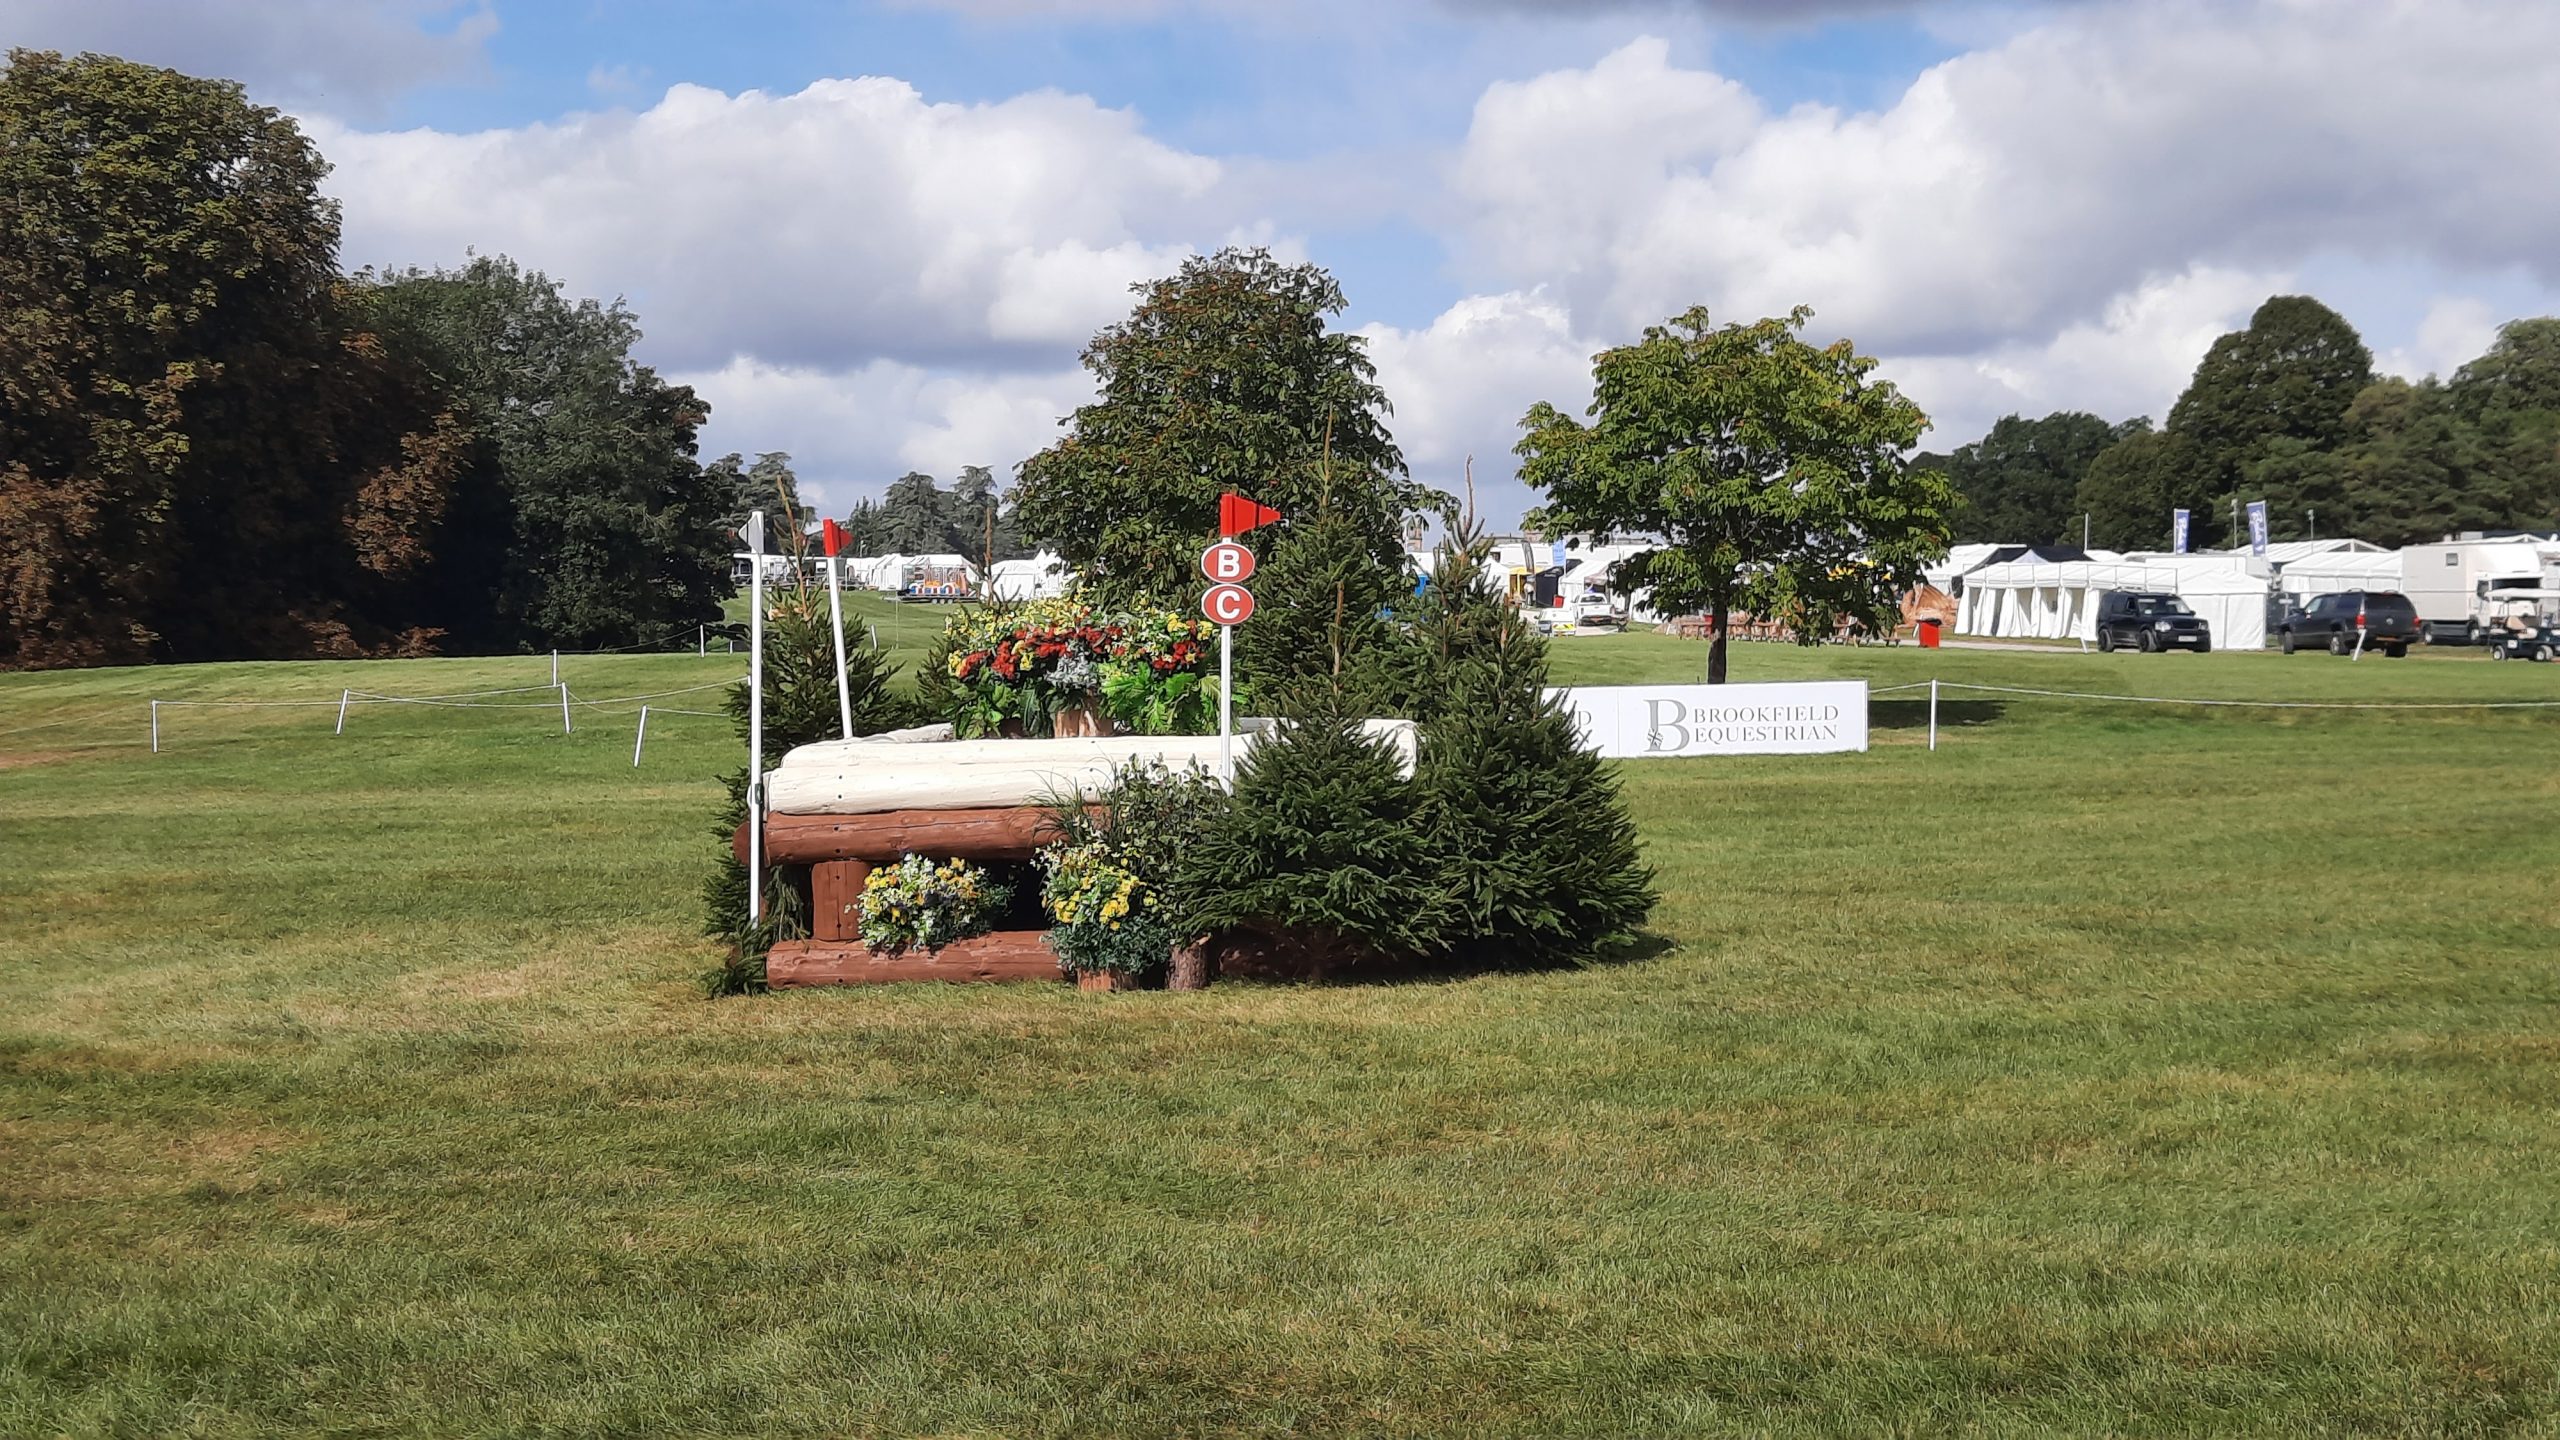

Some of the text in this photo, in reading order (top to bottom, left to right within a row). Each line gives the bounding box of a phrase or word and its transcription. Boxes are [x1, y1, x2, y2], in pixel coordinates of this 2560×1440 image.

[1218, 548, 1241, 577] B
[1216, 590, 1241, 620] C
[1694, 705, 1839, 723] BROOKFIELD
[1695, 724, 1838, 745] EQUESTRIAN
